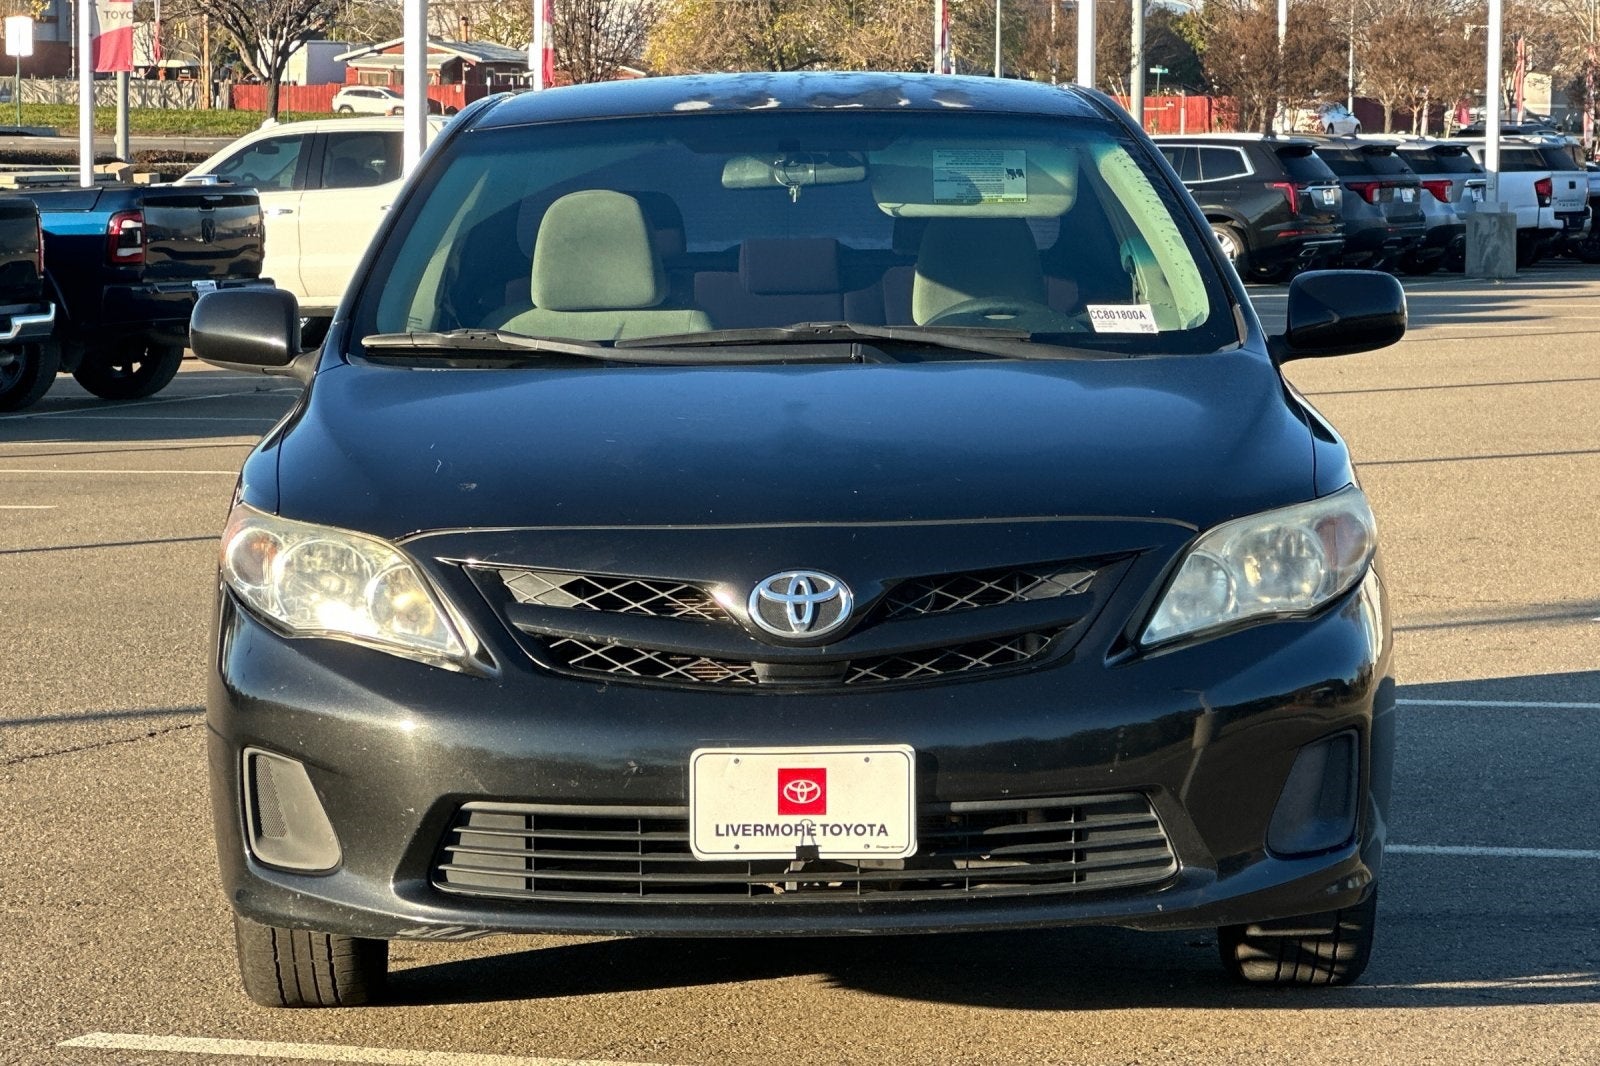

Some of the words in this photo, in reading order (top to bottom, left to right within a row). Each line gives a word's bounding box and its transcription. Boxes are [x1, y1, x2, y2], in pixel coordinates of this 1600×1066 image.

[1090, 310, 1147, 320] CC801800A
[715, 823, 816, 837] LIVERMORE
[820, 823, 889, 837] TOYOTA
